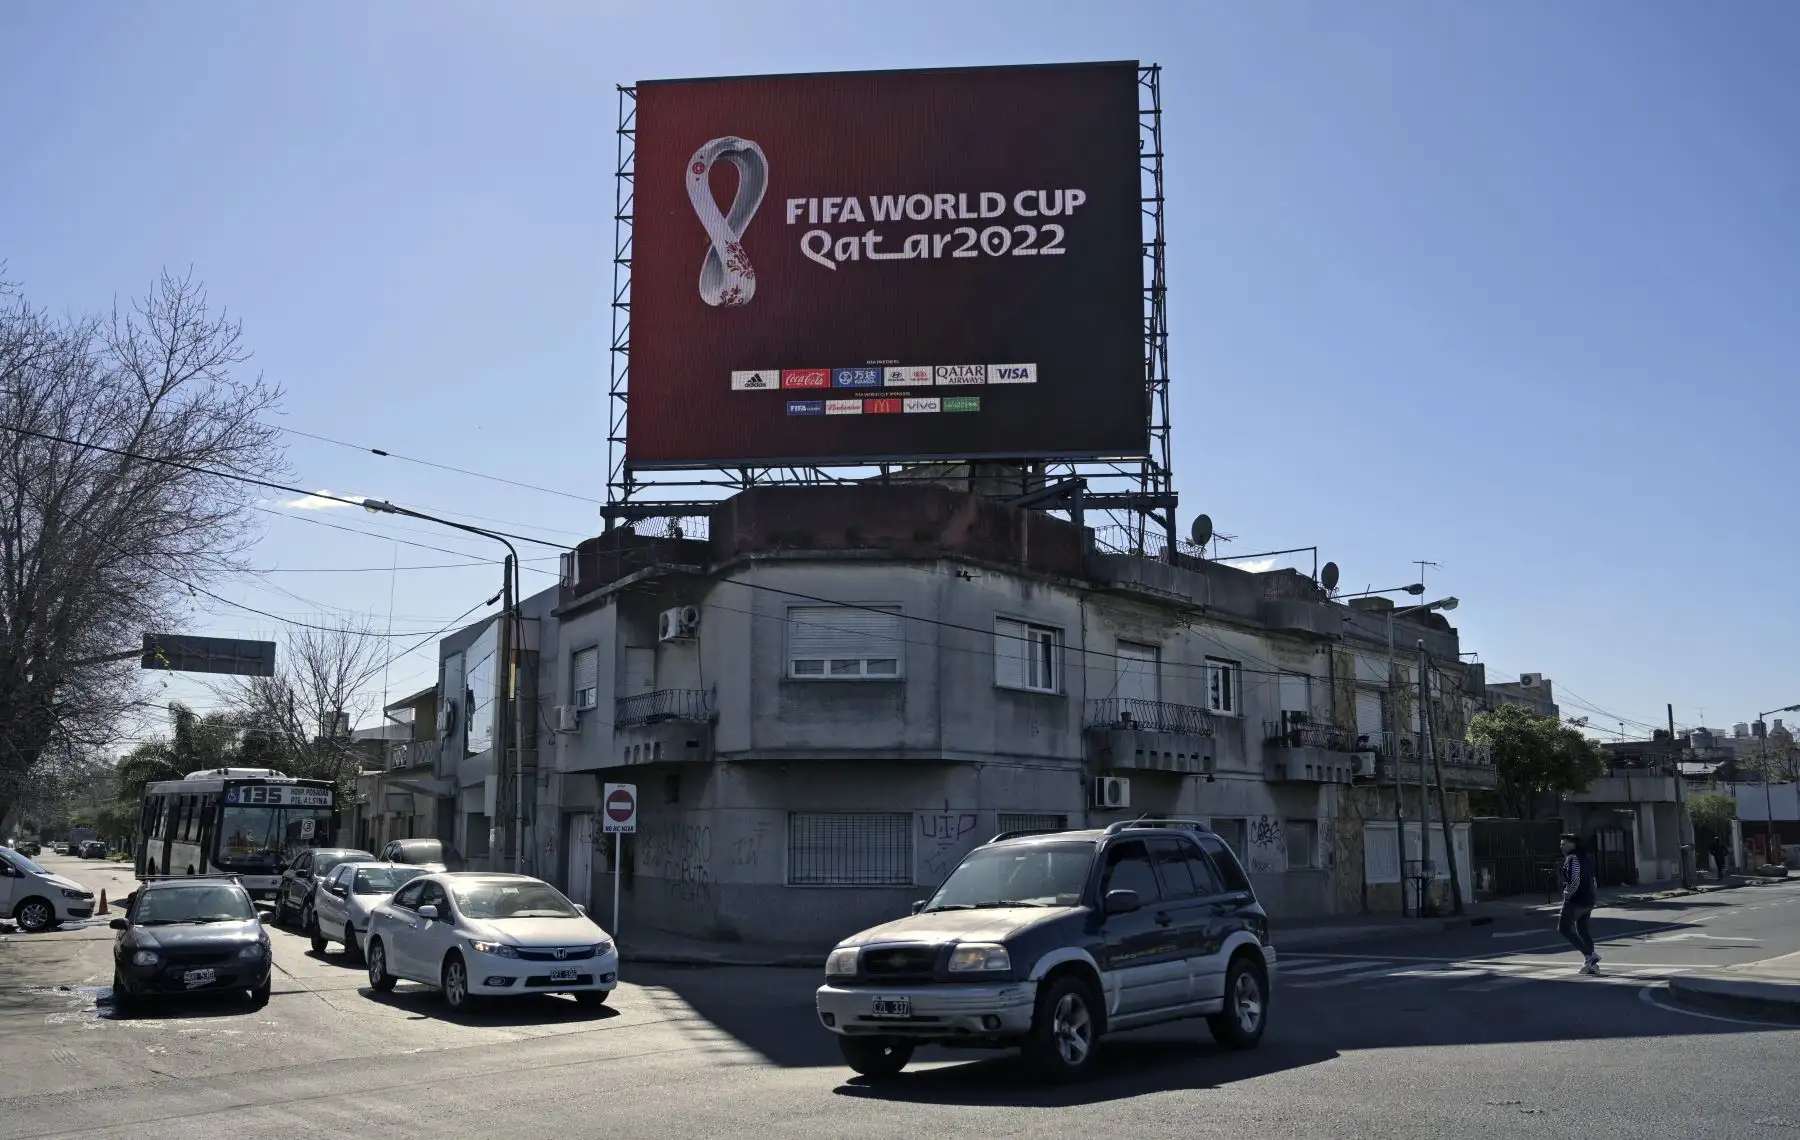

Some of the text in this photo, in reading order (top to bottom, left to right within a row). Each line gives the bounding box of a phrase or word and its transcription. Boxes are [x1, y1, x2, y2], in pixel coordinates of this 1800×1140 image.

[786, 188, 1087, 225] FIFA WORLD CUP
[936, 365, 984, 380] QATAR
[996, 367, 1030, 380] VISA
[948, 376, 984, 385] AIRWAYS
[907, 401, 937, 410] vivo
[242, 786, 282, 803] 135
[873, 1001, 908, 1014] CZL 337
